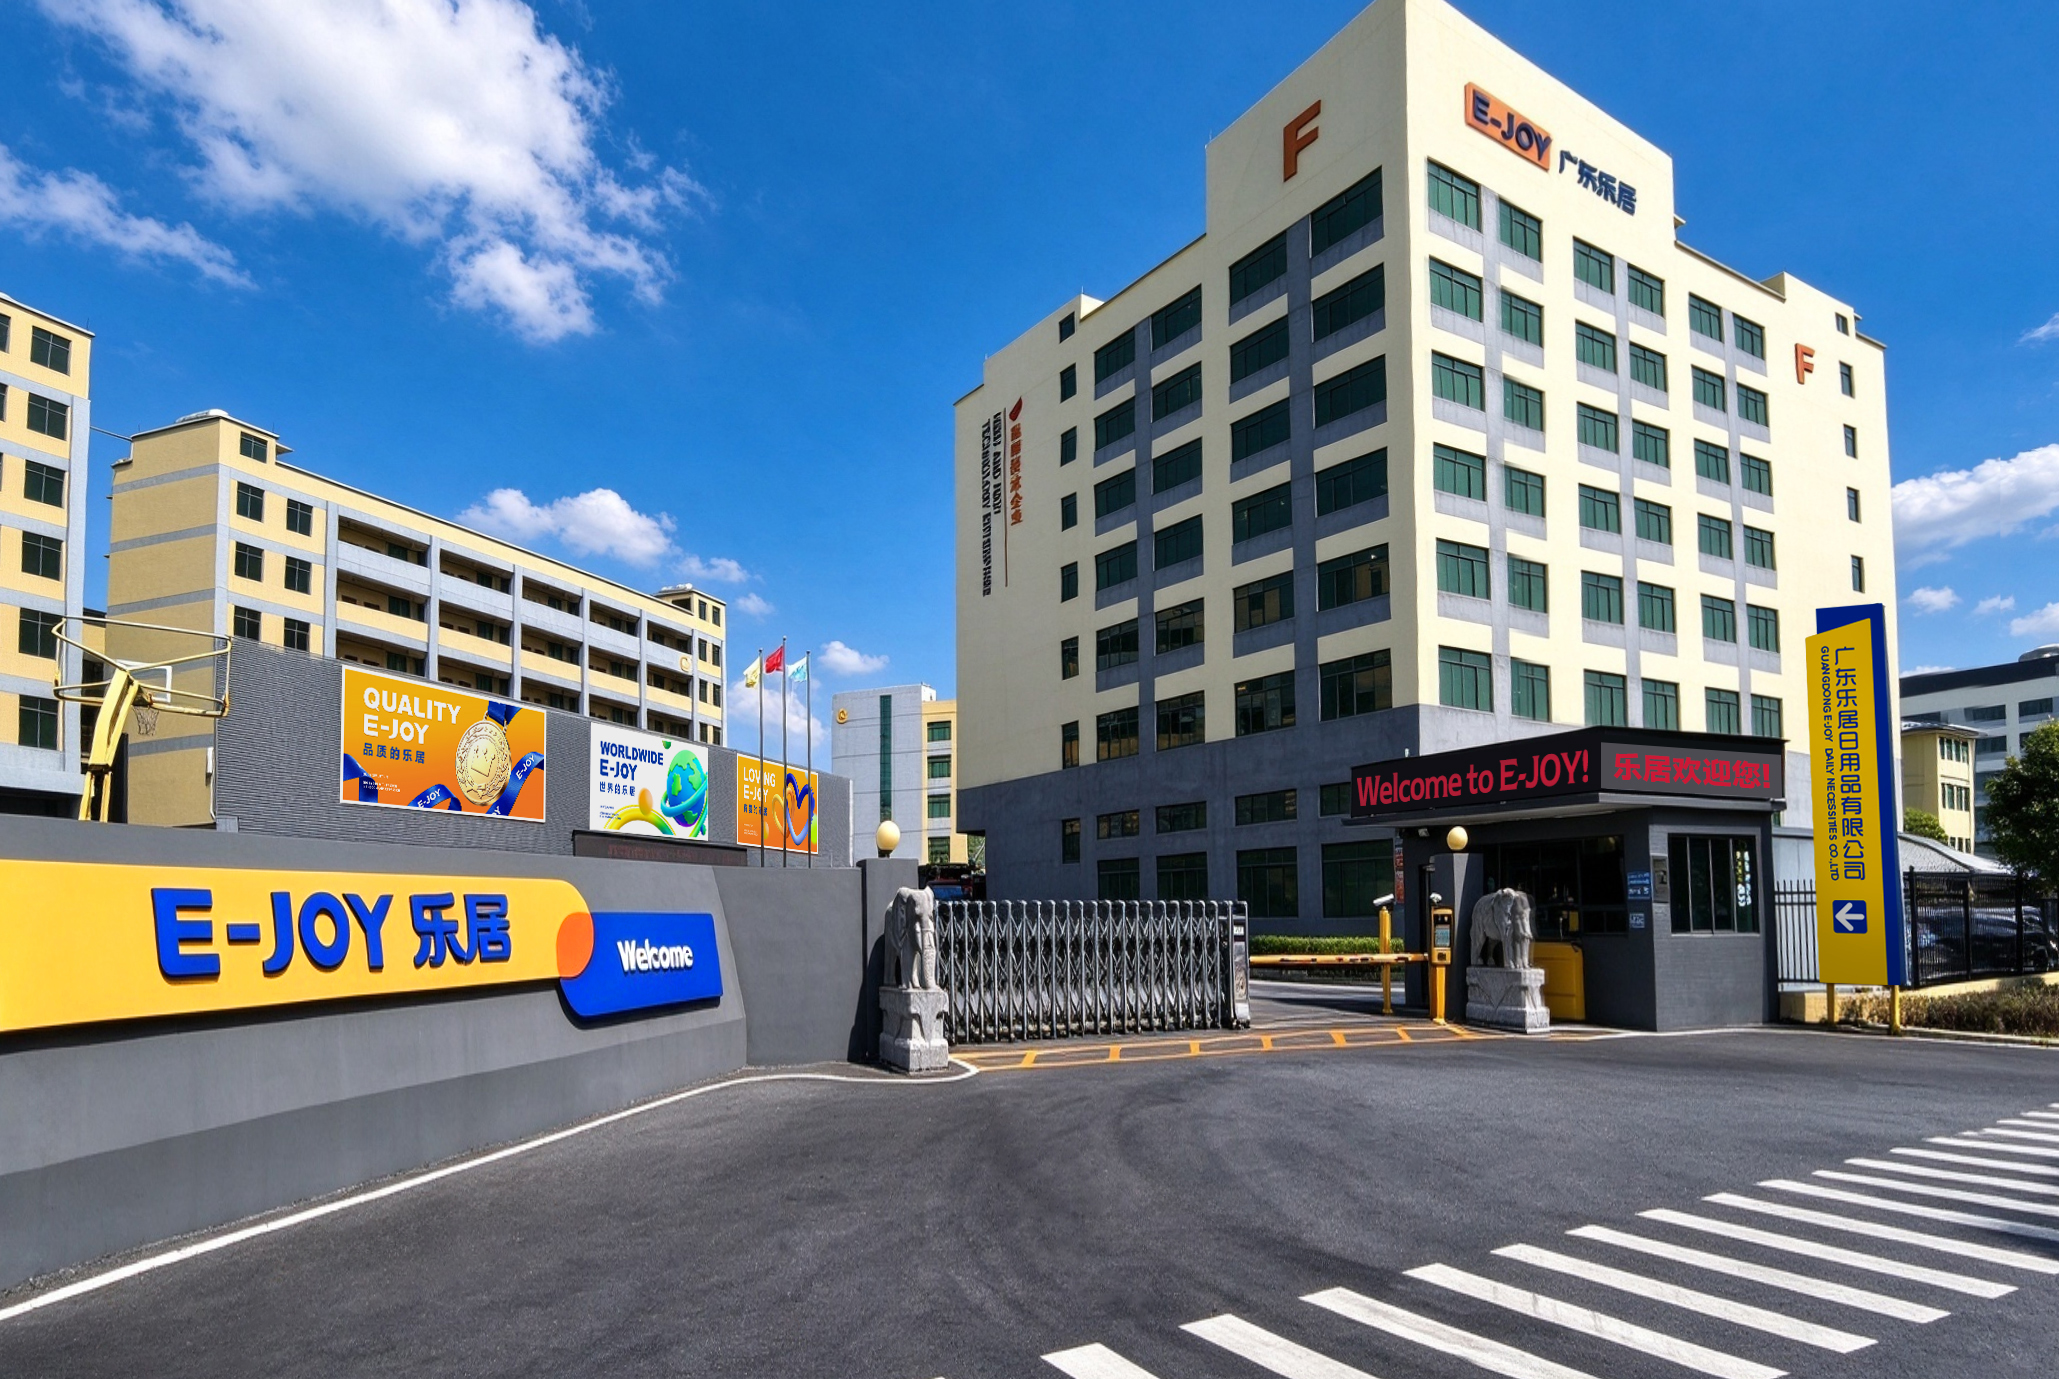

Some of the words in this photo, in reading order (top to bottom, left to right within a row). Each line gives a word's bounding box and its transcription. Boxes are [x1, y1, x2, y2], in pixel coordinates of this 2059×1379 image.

[1283, 99, 1321, 183] F
[1472, 89, 1549, 162] E-JOY
[1559, 149, 1637, 216] 广东乐居
[1794, 342, 1815, 385] F
[1820, 645, 1832, 714] GUANGDONG
[363, 687, 461, 725] QUALITY
[363, 713, 429, 745] E-JOY
[1823, 714, 1834, 743] E-JOY
[363, 742, 425, 765] 品质的乐居
[516, 754, 535, 780] E-JOY
[600, 740, 664, 766] WORLDWIDE
[600, 759, 638, 781] E-JOY
[1614, 753, 1771, 789] 乐居欢迎您!
[1825, 748, 1835, 776] DAILY
[1835, 646, 1865, 881] 广东乐居日用品有限公司
[743, 767, 776, 788] LOVNG
[1356, 772, 1462, 807] Welcome
[1466, 764, 1494, 795] to
[1499, 749, 1589, 791] E-JOY!
[417, 788, 441, 809] E-JOY
[1826, 778, 1837, 841] NECESSITIES
[1828, 843, 1840, 881] CO.,LTD
[152, 887, 394, 979] E-JOY
[409, 891, 512, 968] 乐居
[616, 938, 694, 973] Welcome
